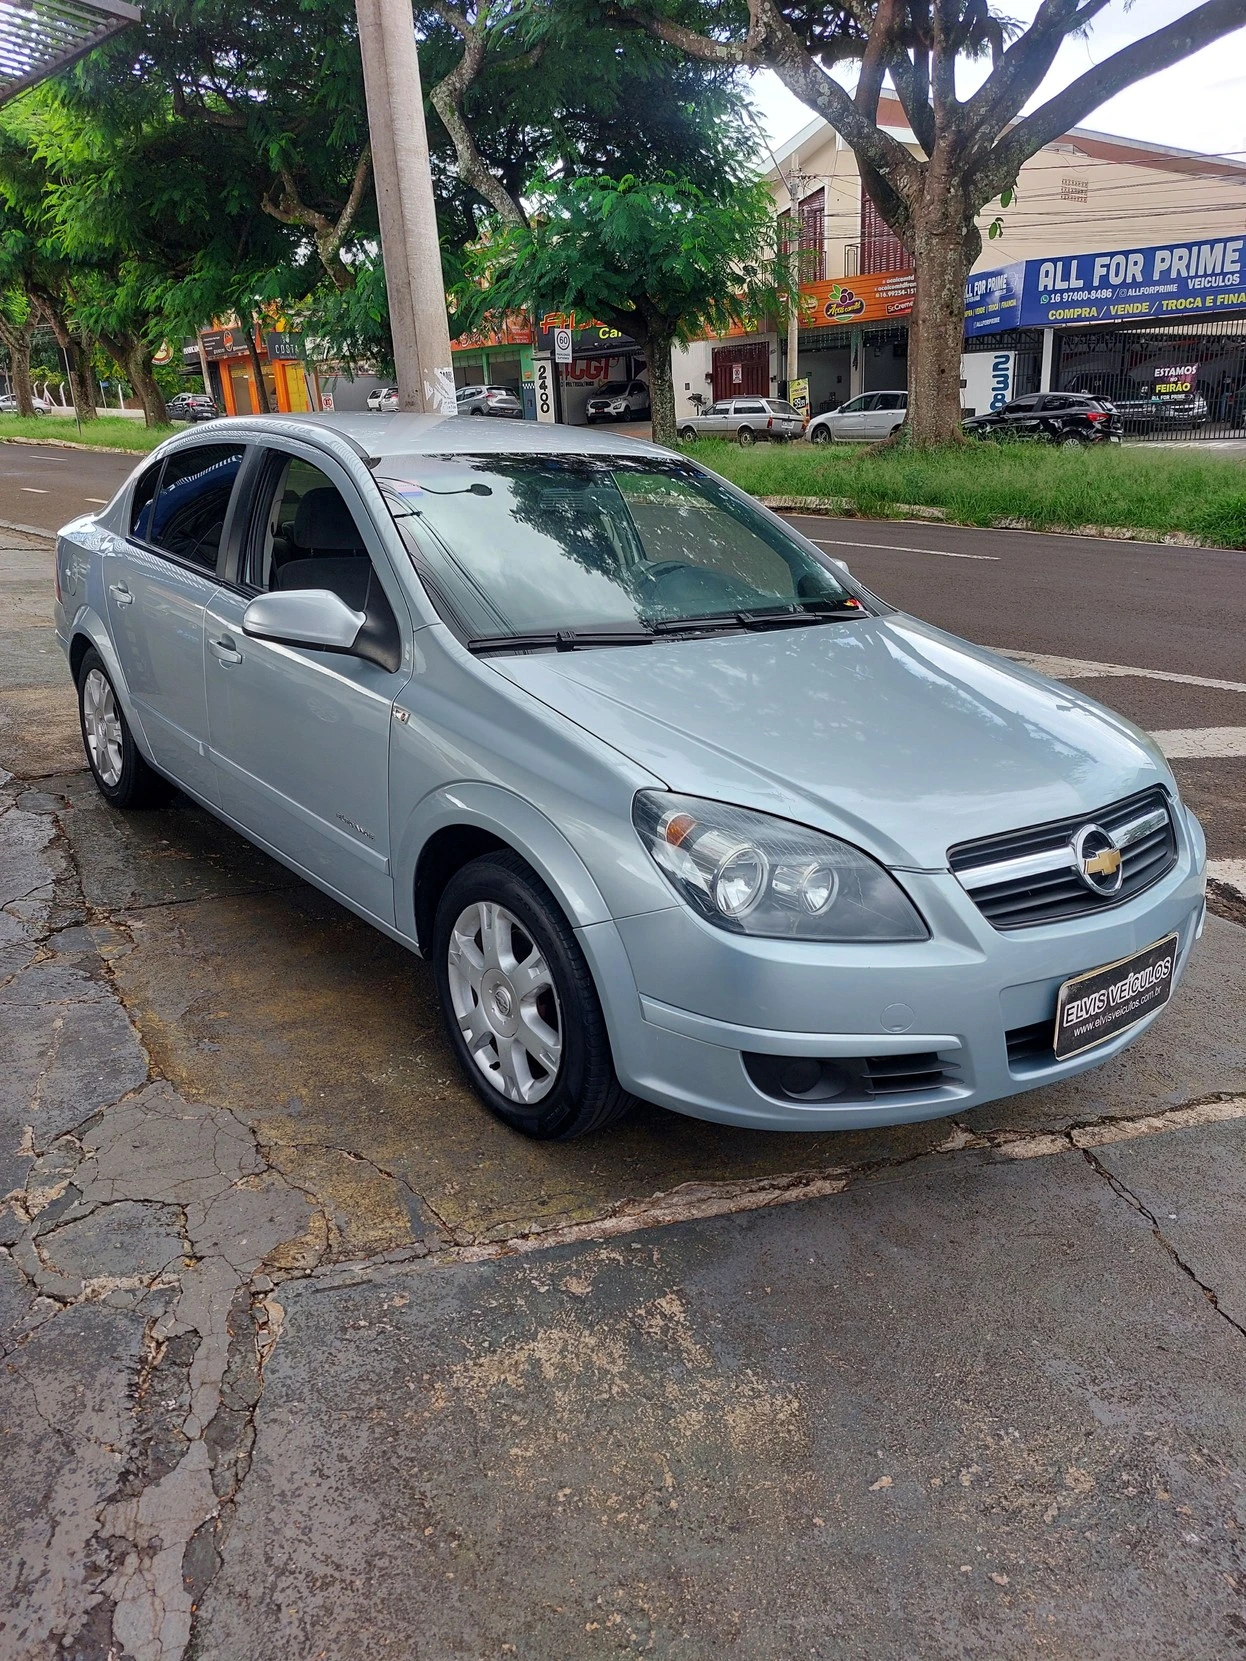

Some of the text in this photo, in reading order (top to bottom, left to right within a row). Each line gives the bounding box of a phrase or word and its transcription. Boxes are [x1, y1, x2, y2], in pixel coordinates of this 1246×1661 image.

[1038, 240, 1244, 291] ALL FOR PRIME
[974, 280, 987, 297] FOR
[987, 273, 1008, 293] PRIME
[1187, 273, 1240, 289] VEICULOS
[1050, 293, 1061, 303] 16
[1062, 289, 1112, 302] 97400-8486
[1127, 284, 1178, 296] ALLFORPRIME
[1048, 307, 1097, 320] COMPRA
[1110, 302, 1150, 315] VENDE
[1162, 297, 1202, 311] TROCA
[1205, 296, 1214, 307] E
[559, 336, 568, 345] 60
[1154, 365, 1197, 378] ESTAMOS
[538, 365, 550, 414] 2400
[1155, 381, 1191, 393] FEIRÃO
[1063, 956, 1172, 1028] ELVIS VEÍCULOS
[1073, 985, 1162, 1037] www.elvisveiculos.com.br
